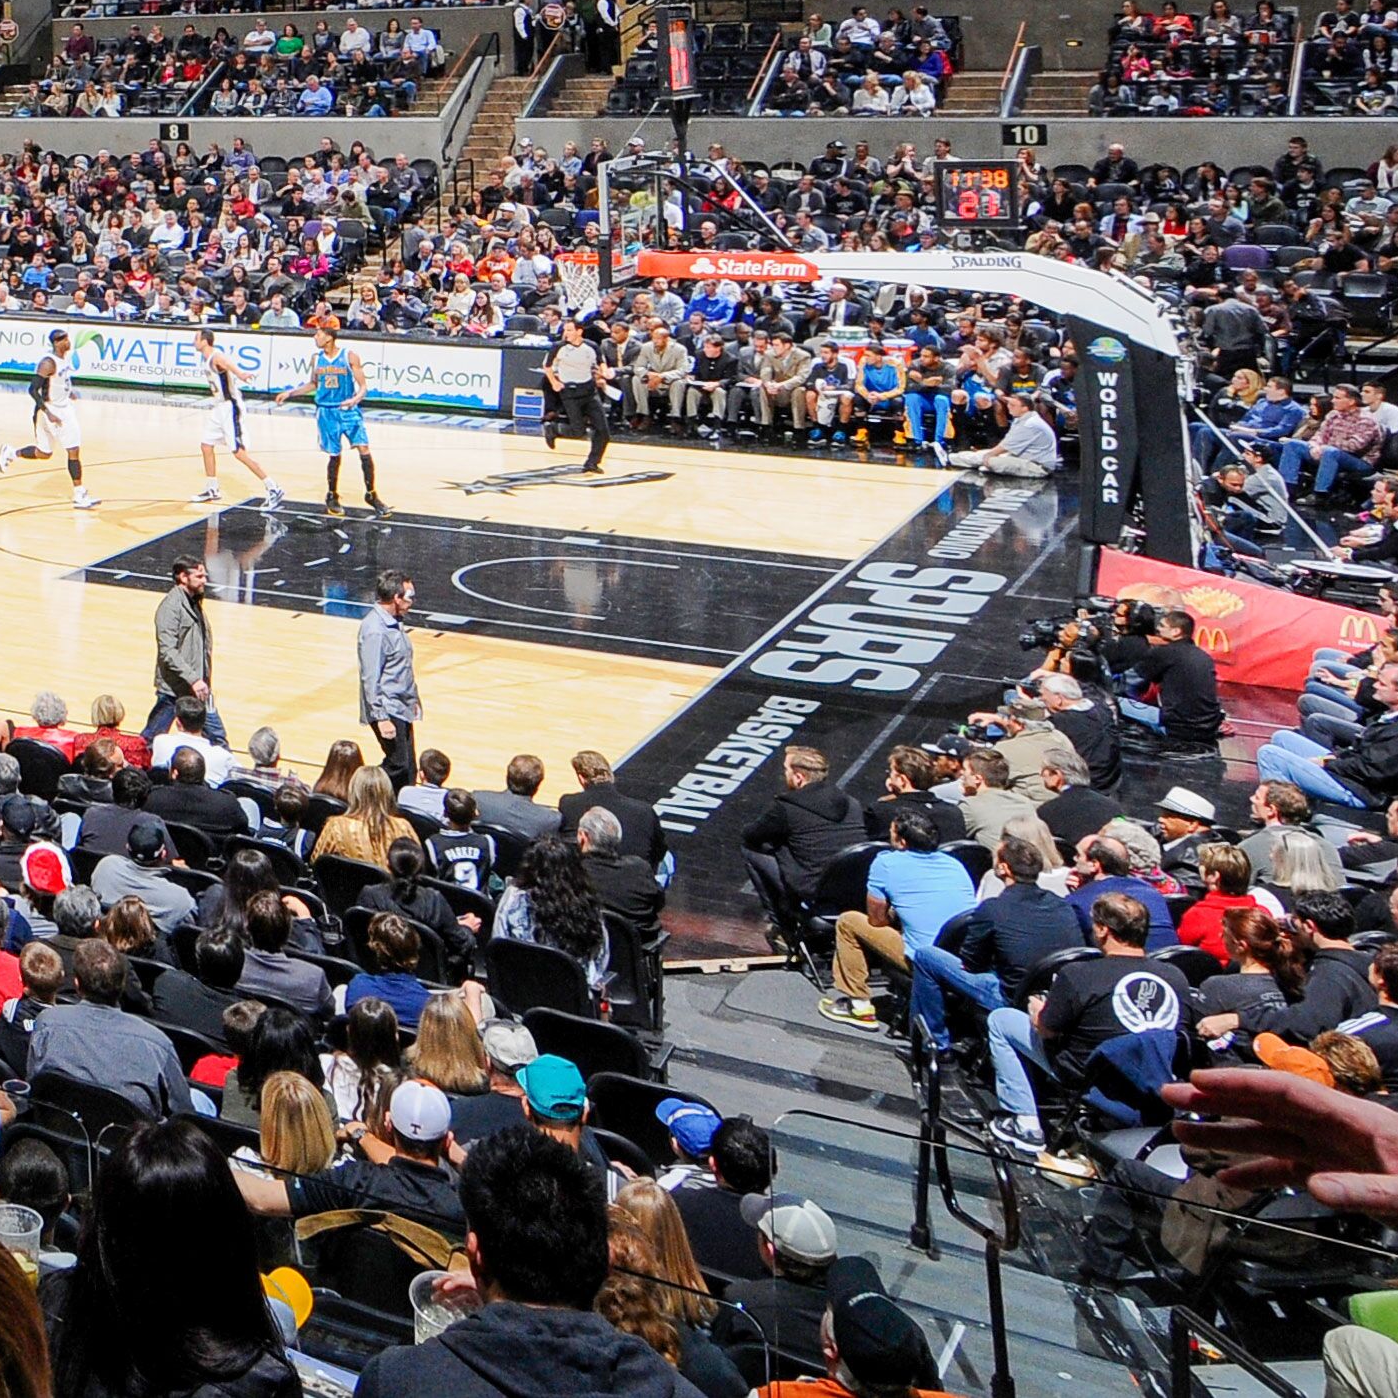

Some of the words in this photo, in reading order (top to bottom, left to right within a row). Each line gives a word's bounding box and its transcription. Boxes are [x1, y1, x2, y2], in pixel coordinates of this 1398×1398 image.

[169, 124, 180, 139] 8
[1011, 126, 1038, 145] 10
[951, 255, 1023, 270] SPALDING
[1097, 370, 1120, 452] WORLD
[1100, 457, 1119, 505] CAR
[978, 488, 1036, 512] SAN
[927, 509, 1011, 559] ANTONIO
[749, 561, 1008, 693] SPURS
[453, 861, 479, 891] 9
